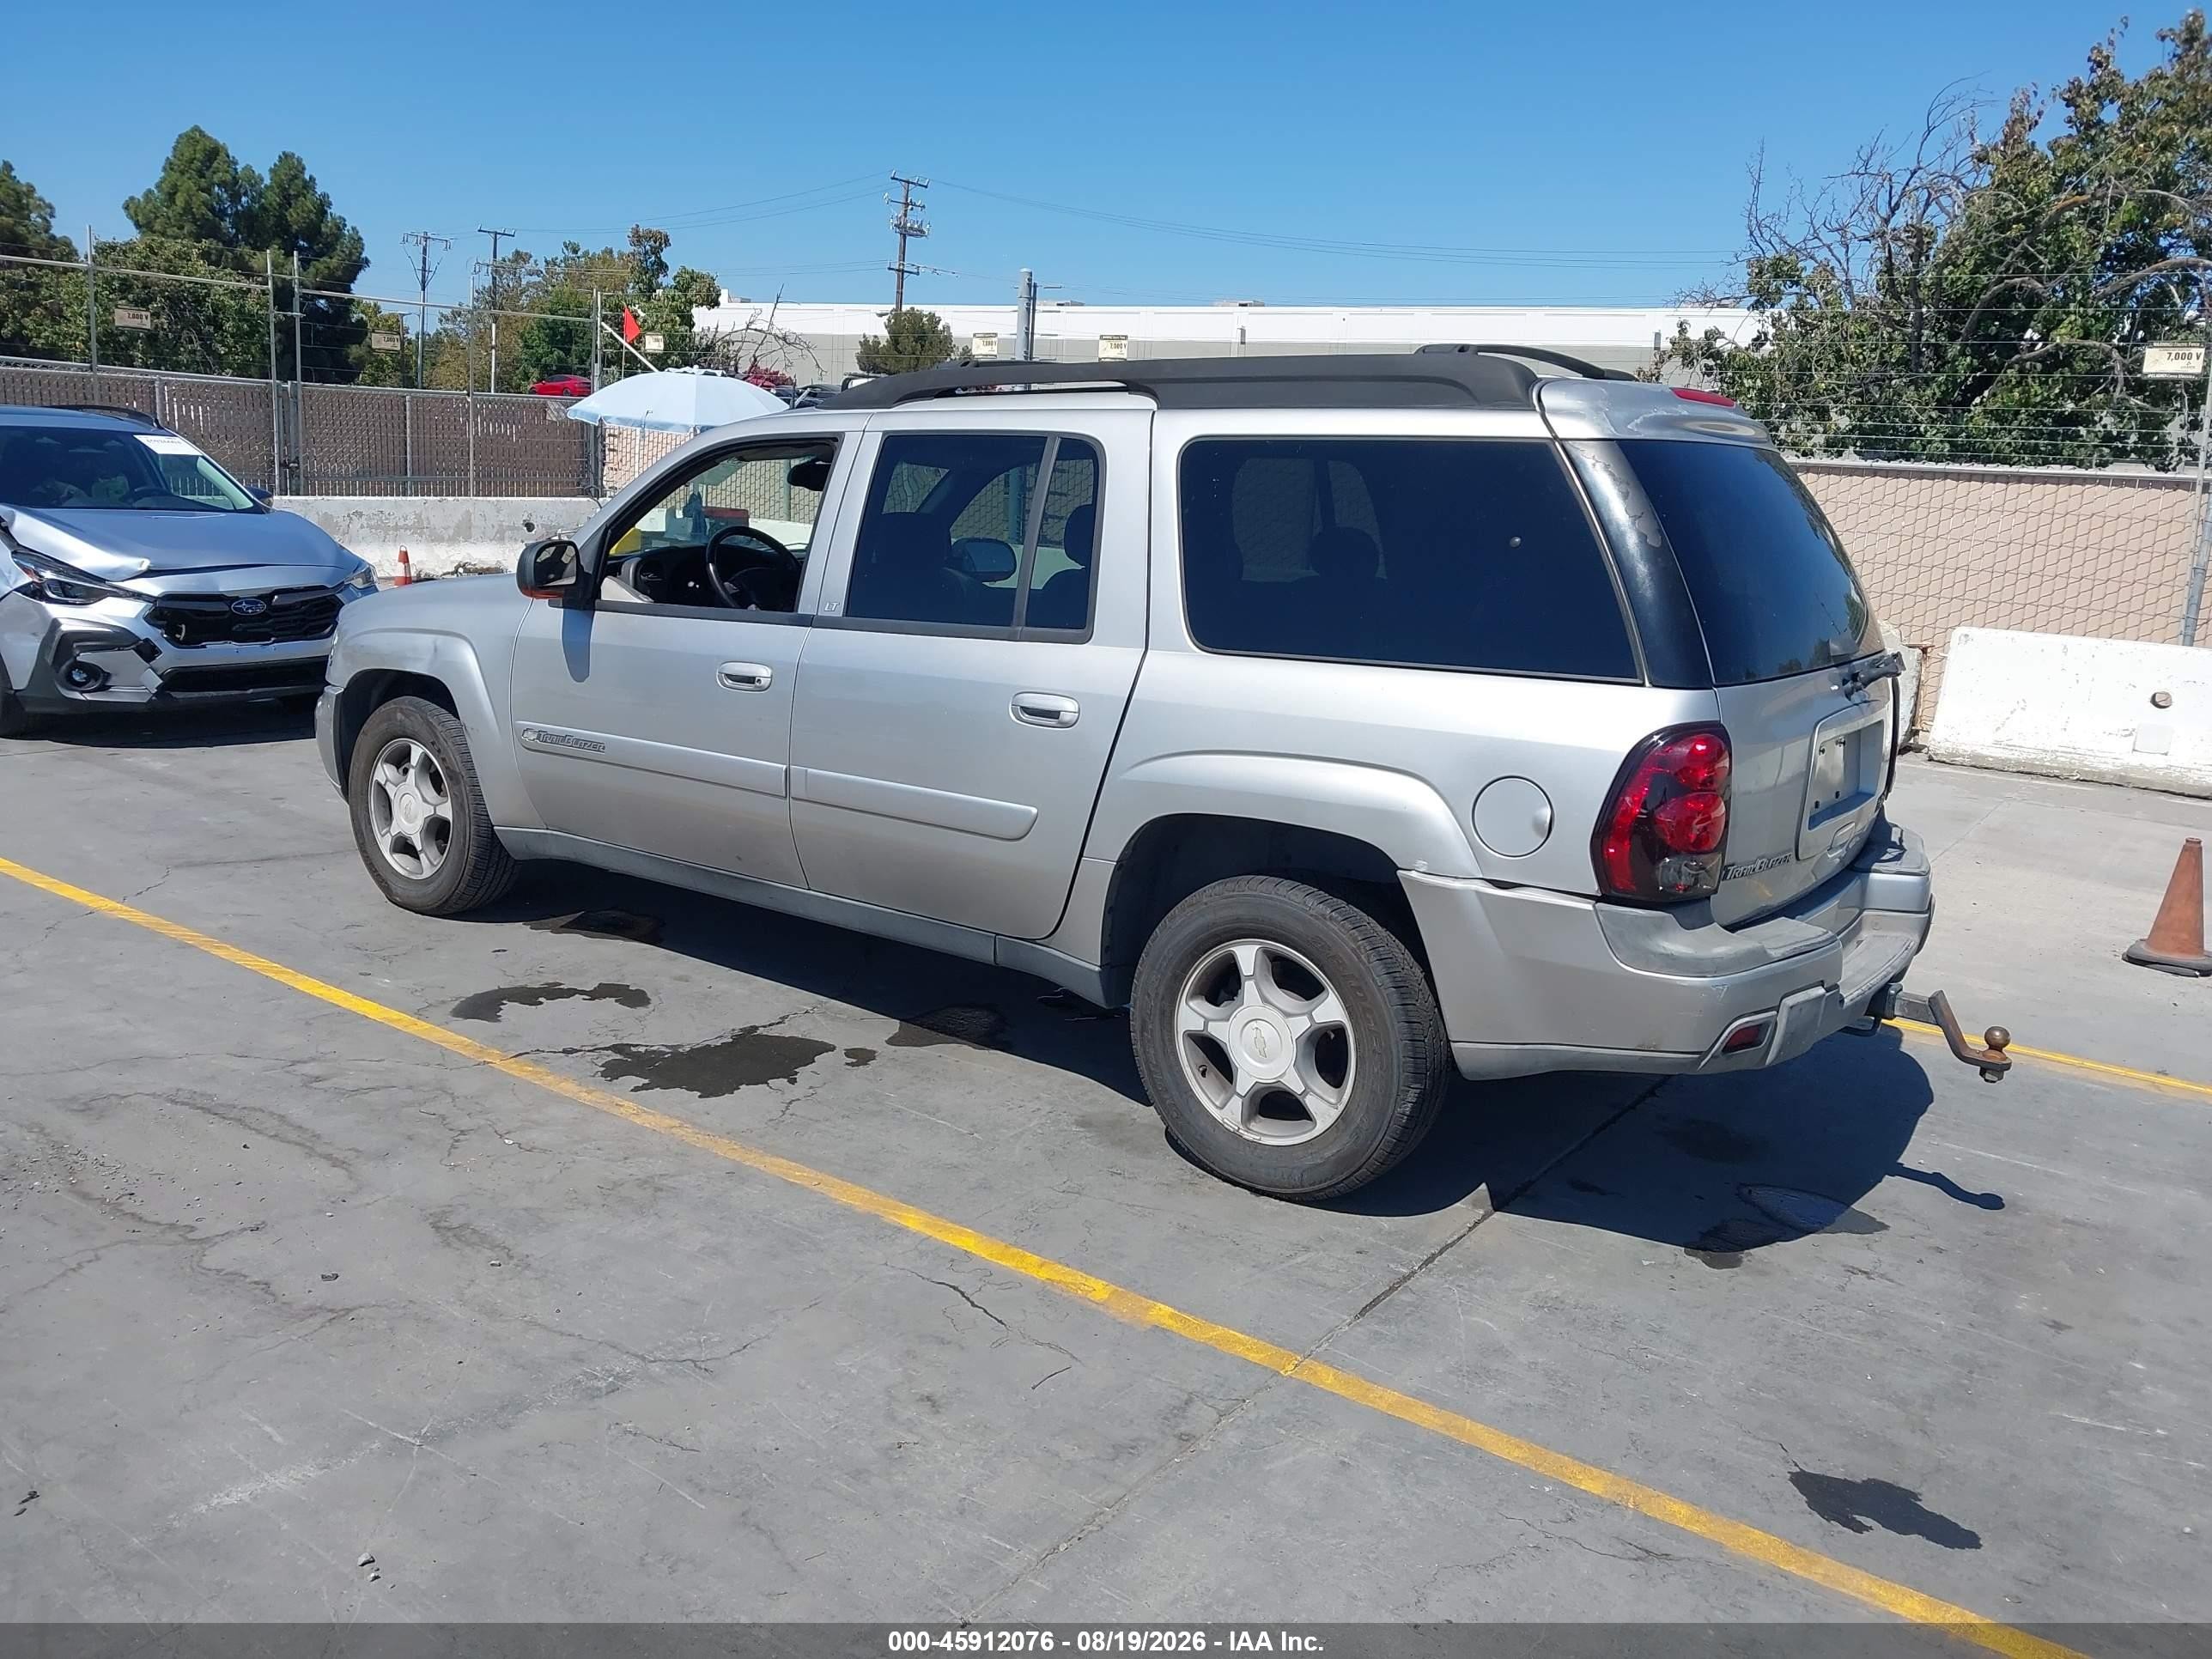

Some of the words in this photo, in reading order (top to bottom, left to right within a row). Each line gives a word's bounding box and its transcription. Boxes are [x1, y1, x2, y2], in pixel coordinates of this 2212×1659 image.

[2166, 352, 2192, 362] 7,000
[2196, 352, 2202, 361] V
[824, 602, 839, 611] LT
